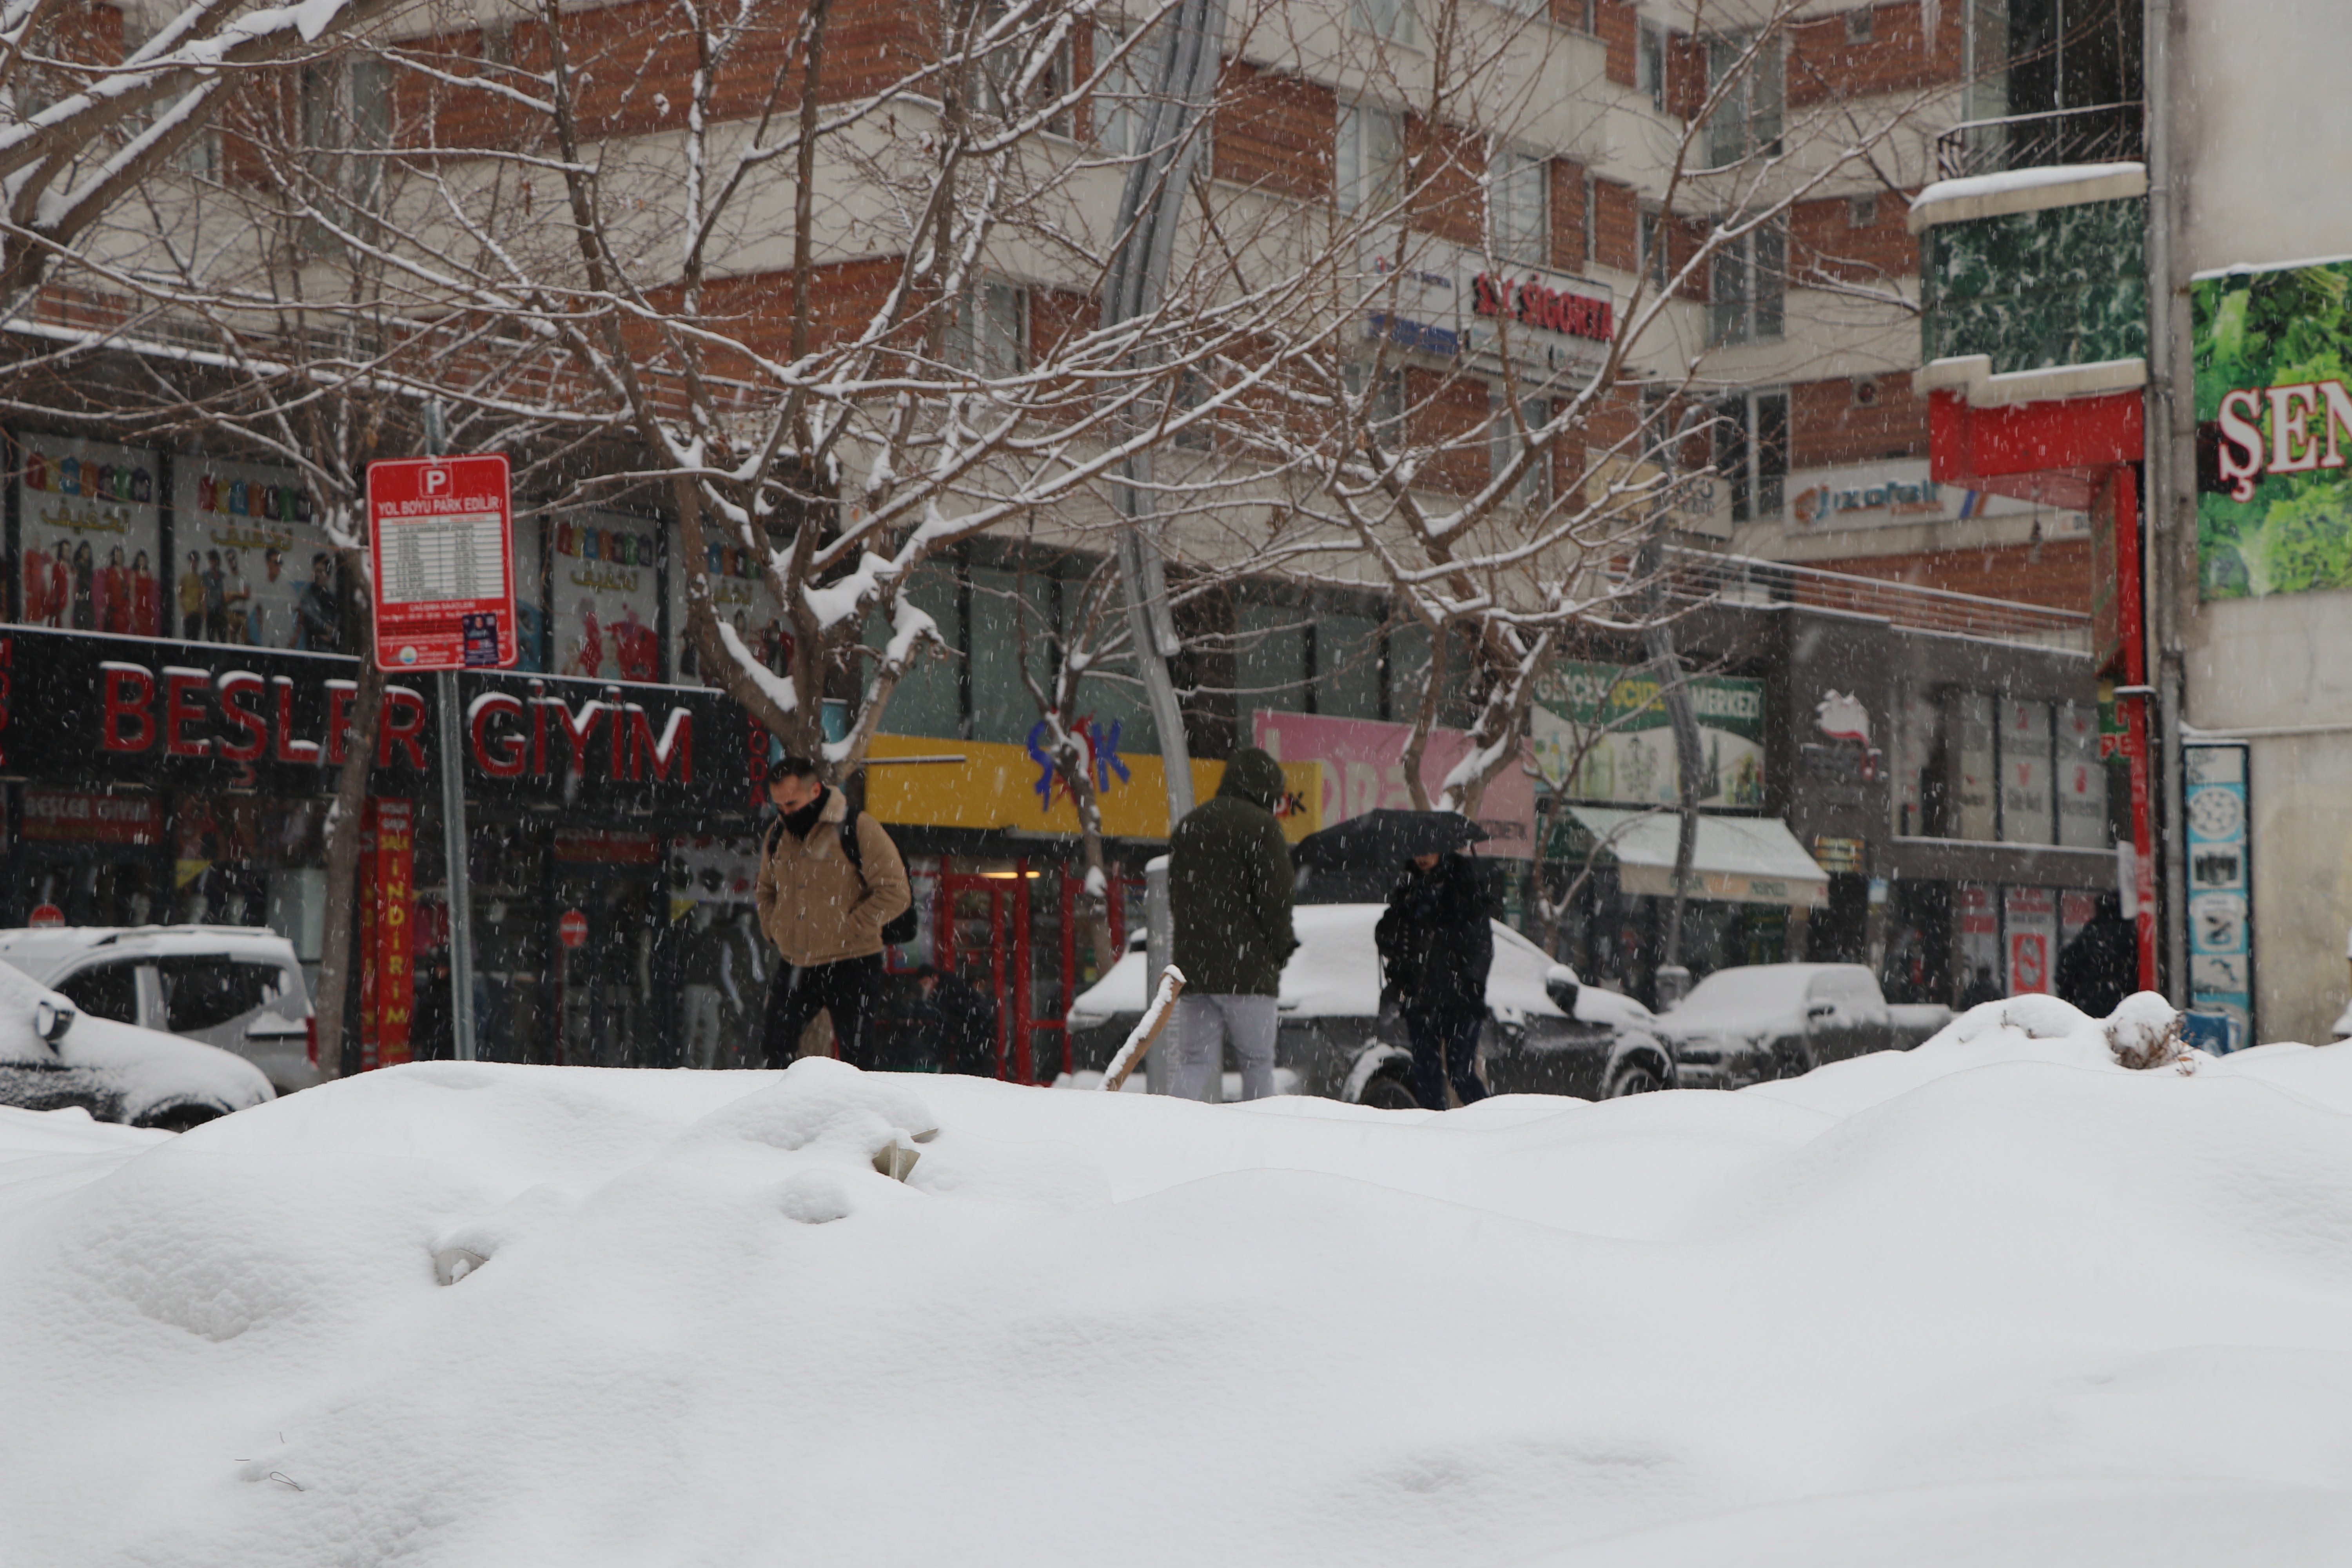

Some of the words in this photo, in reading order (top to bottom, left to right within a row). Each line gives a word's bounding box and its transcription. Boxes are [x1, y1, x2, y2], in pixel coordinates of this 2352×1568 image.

[377, 501, 400, 516] YOL
[400, 499, 431, 515] BOYU
[432, 497, 463, 513] PARK
[464, 493, 500, 512] EDİLİR
[426, 470, 446, 494] P
[100, 662, 428, 785] BEŞLER
[470, 680, 692, 784] GİYİM
[385, 857, 408, 1024] İNDİRİM
